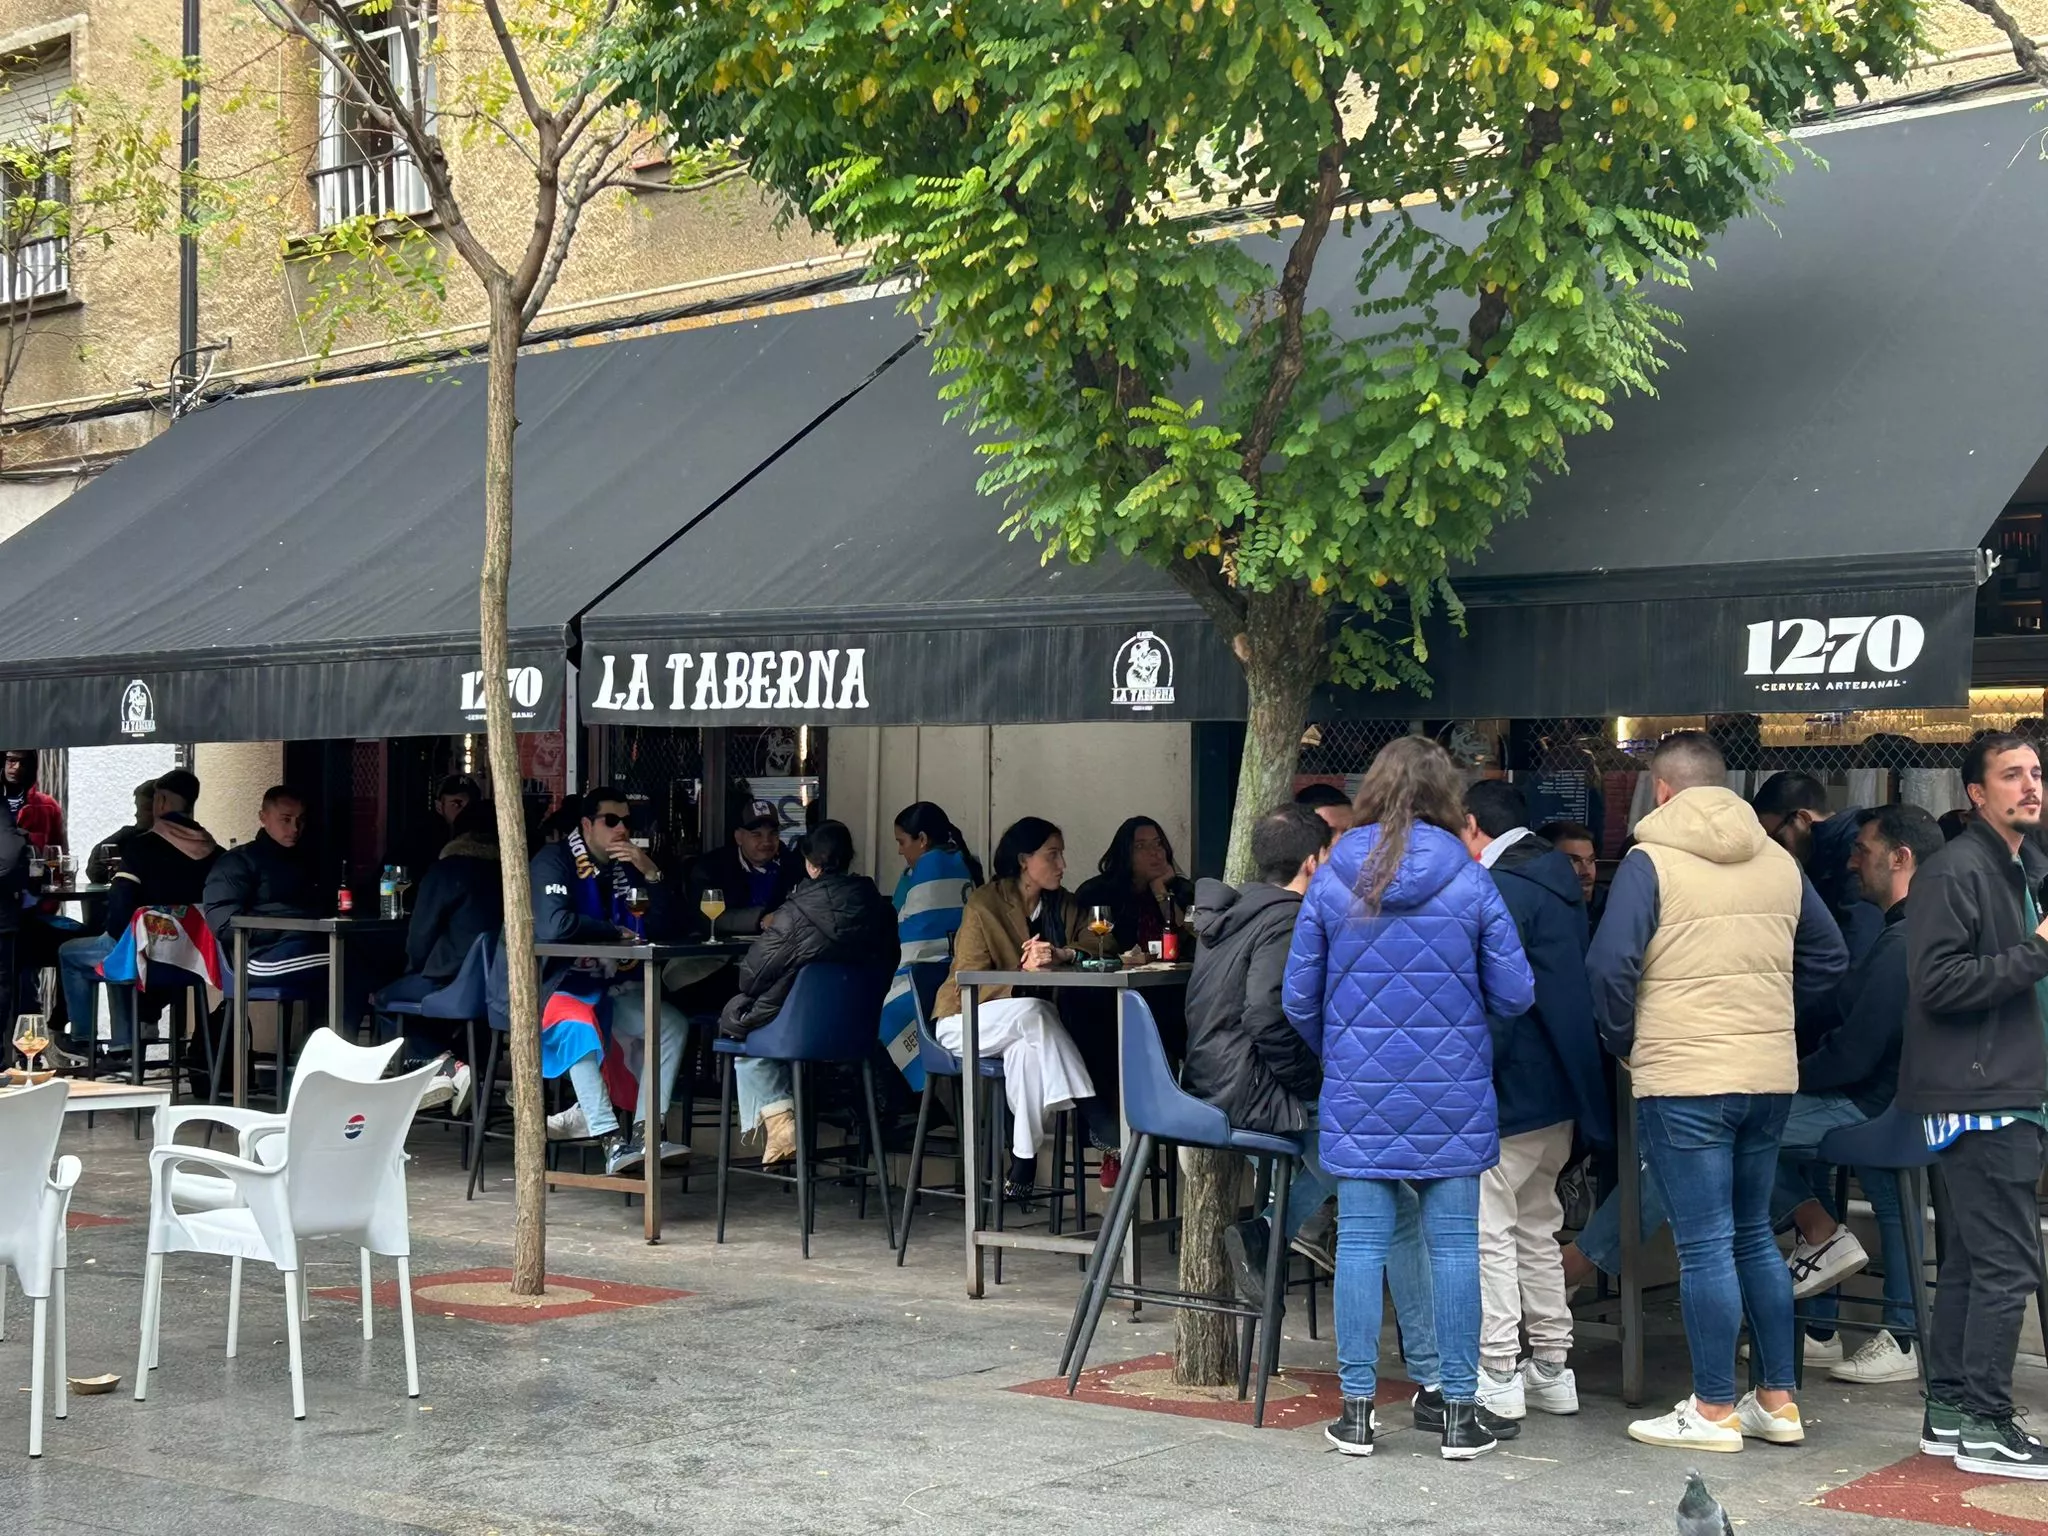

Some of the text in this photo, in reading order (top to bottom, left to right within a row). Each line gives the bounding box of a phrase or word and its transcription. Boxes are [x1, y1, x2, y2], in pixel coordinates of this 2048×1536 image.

[1744, 614, 1925, 675] 1270
[460, 666, 543, 710] 10
[592, 648, 869, 711] LA TABERNA
[1112, 688, 1127, 702] LA
[1761, 679, 1901, 692] CERVEZA ARTESANAL
